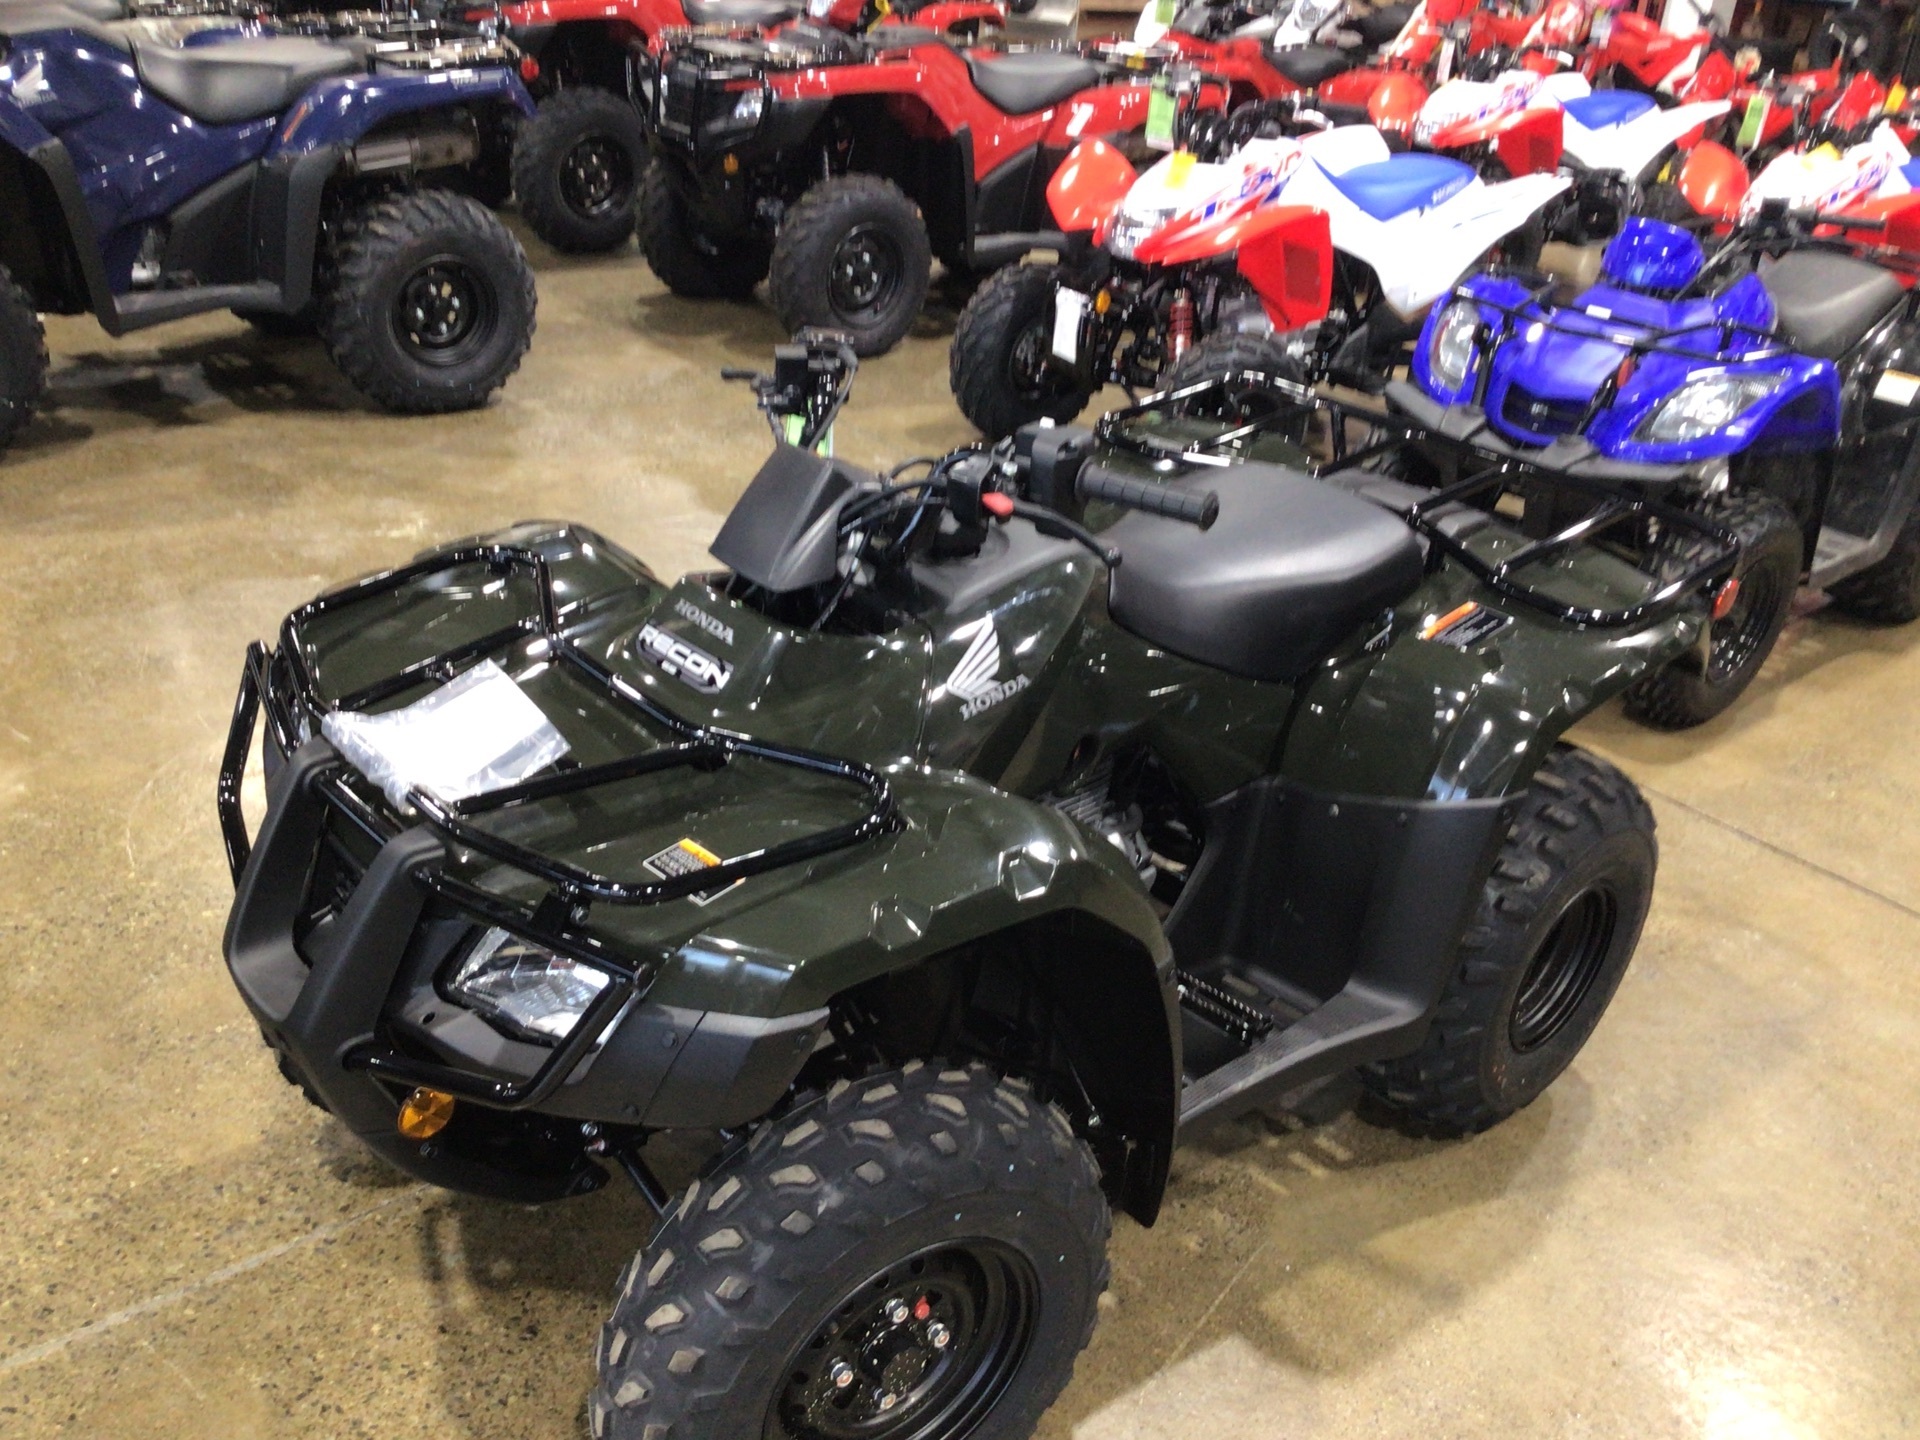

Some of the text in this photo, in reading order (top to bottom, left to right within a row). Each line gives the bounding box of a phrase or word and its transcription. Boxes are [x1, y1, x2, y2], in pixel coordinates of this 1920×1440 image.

[674, 598, 734, 646] HONDA
[639, 624, 731, 690] RECON
[959, 674, 1032, 721] HONDA
